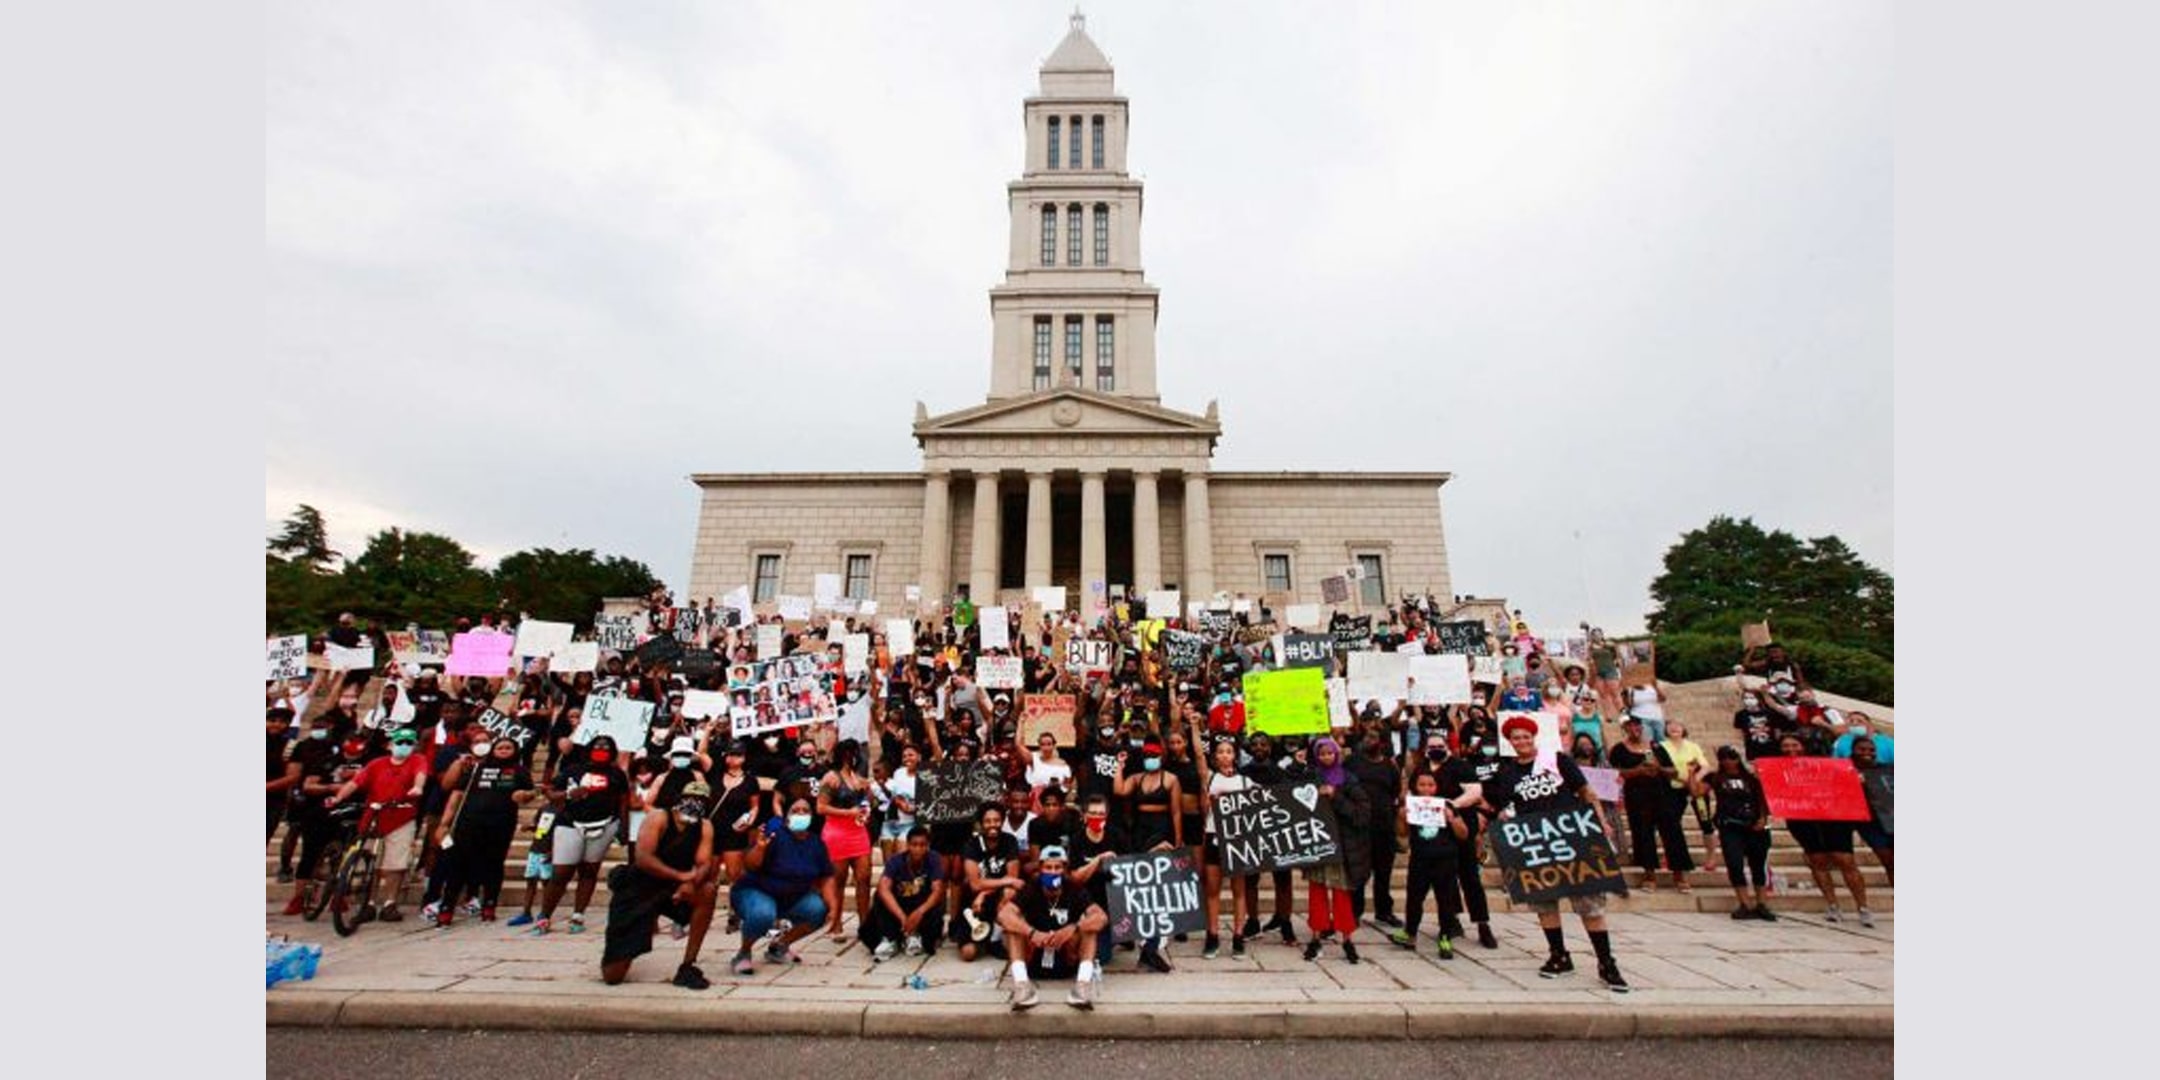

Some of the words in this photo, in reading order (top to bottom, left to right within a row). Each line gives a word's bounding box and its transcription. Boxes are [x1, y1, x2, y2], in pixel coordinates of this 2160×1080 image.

[1068, 641, 1112, 665] BLM
[1284, 640, 1334, 661] #BLM
[477, 708, 533, 748] BLACK
[1218, 788, 1278, 815] BLACK
[1222, 804, 1291, 839] LIVES
[1502, 809, 1603, 848] BLACK
[1226, 817, 1332, 872] MATTER
[1521, 839, 1577, 867] IS
[1110, 856, 1171, 885] STOP
[1519, 857, 1620, 894] ROYAL
[1124, 872, 1200, 914] KILLIN'
[1137, 913, 1174, 938] US
